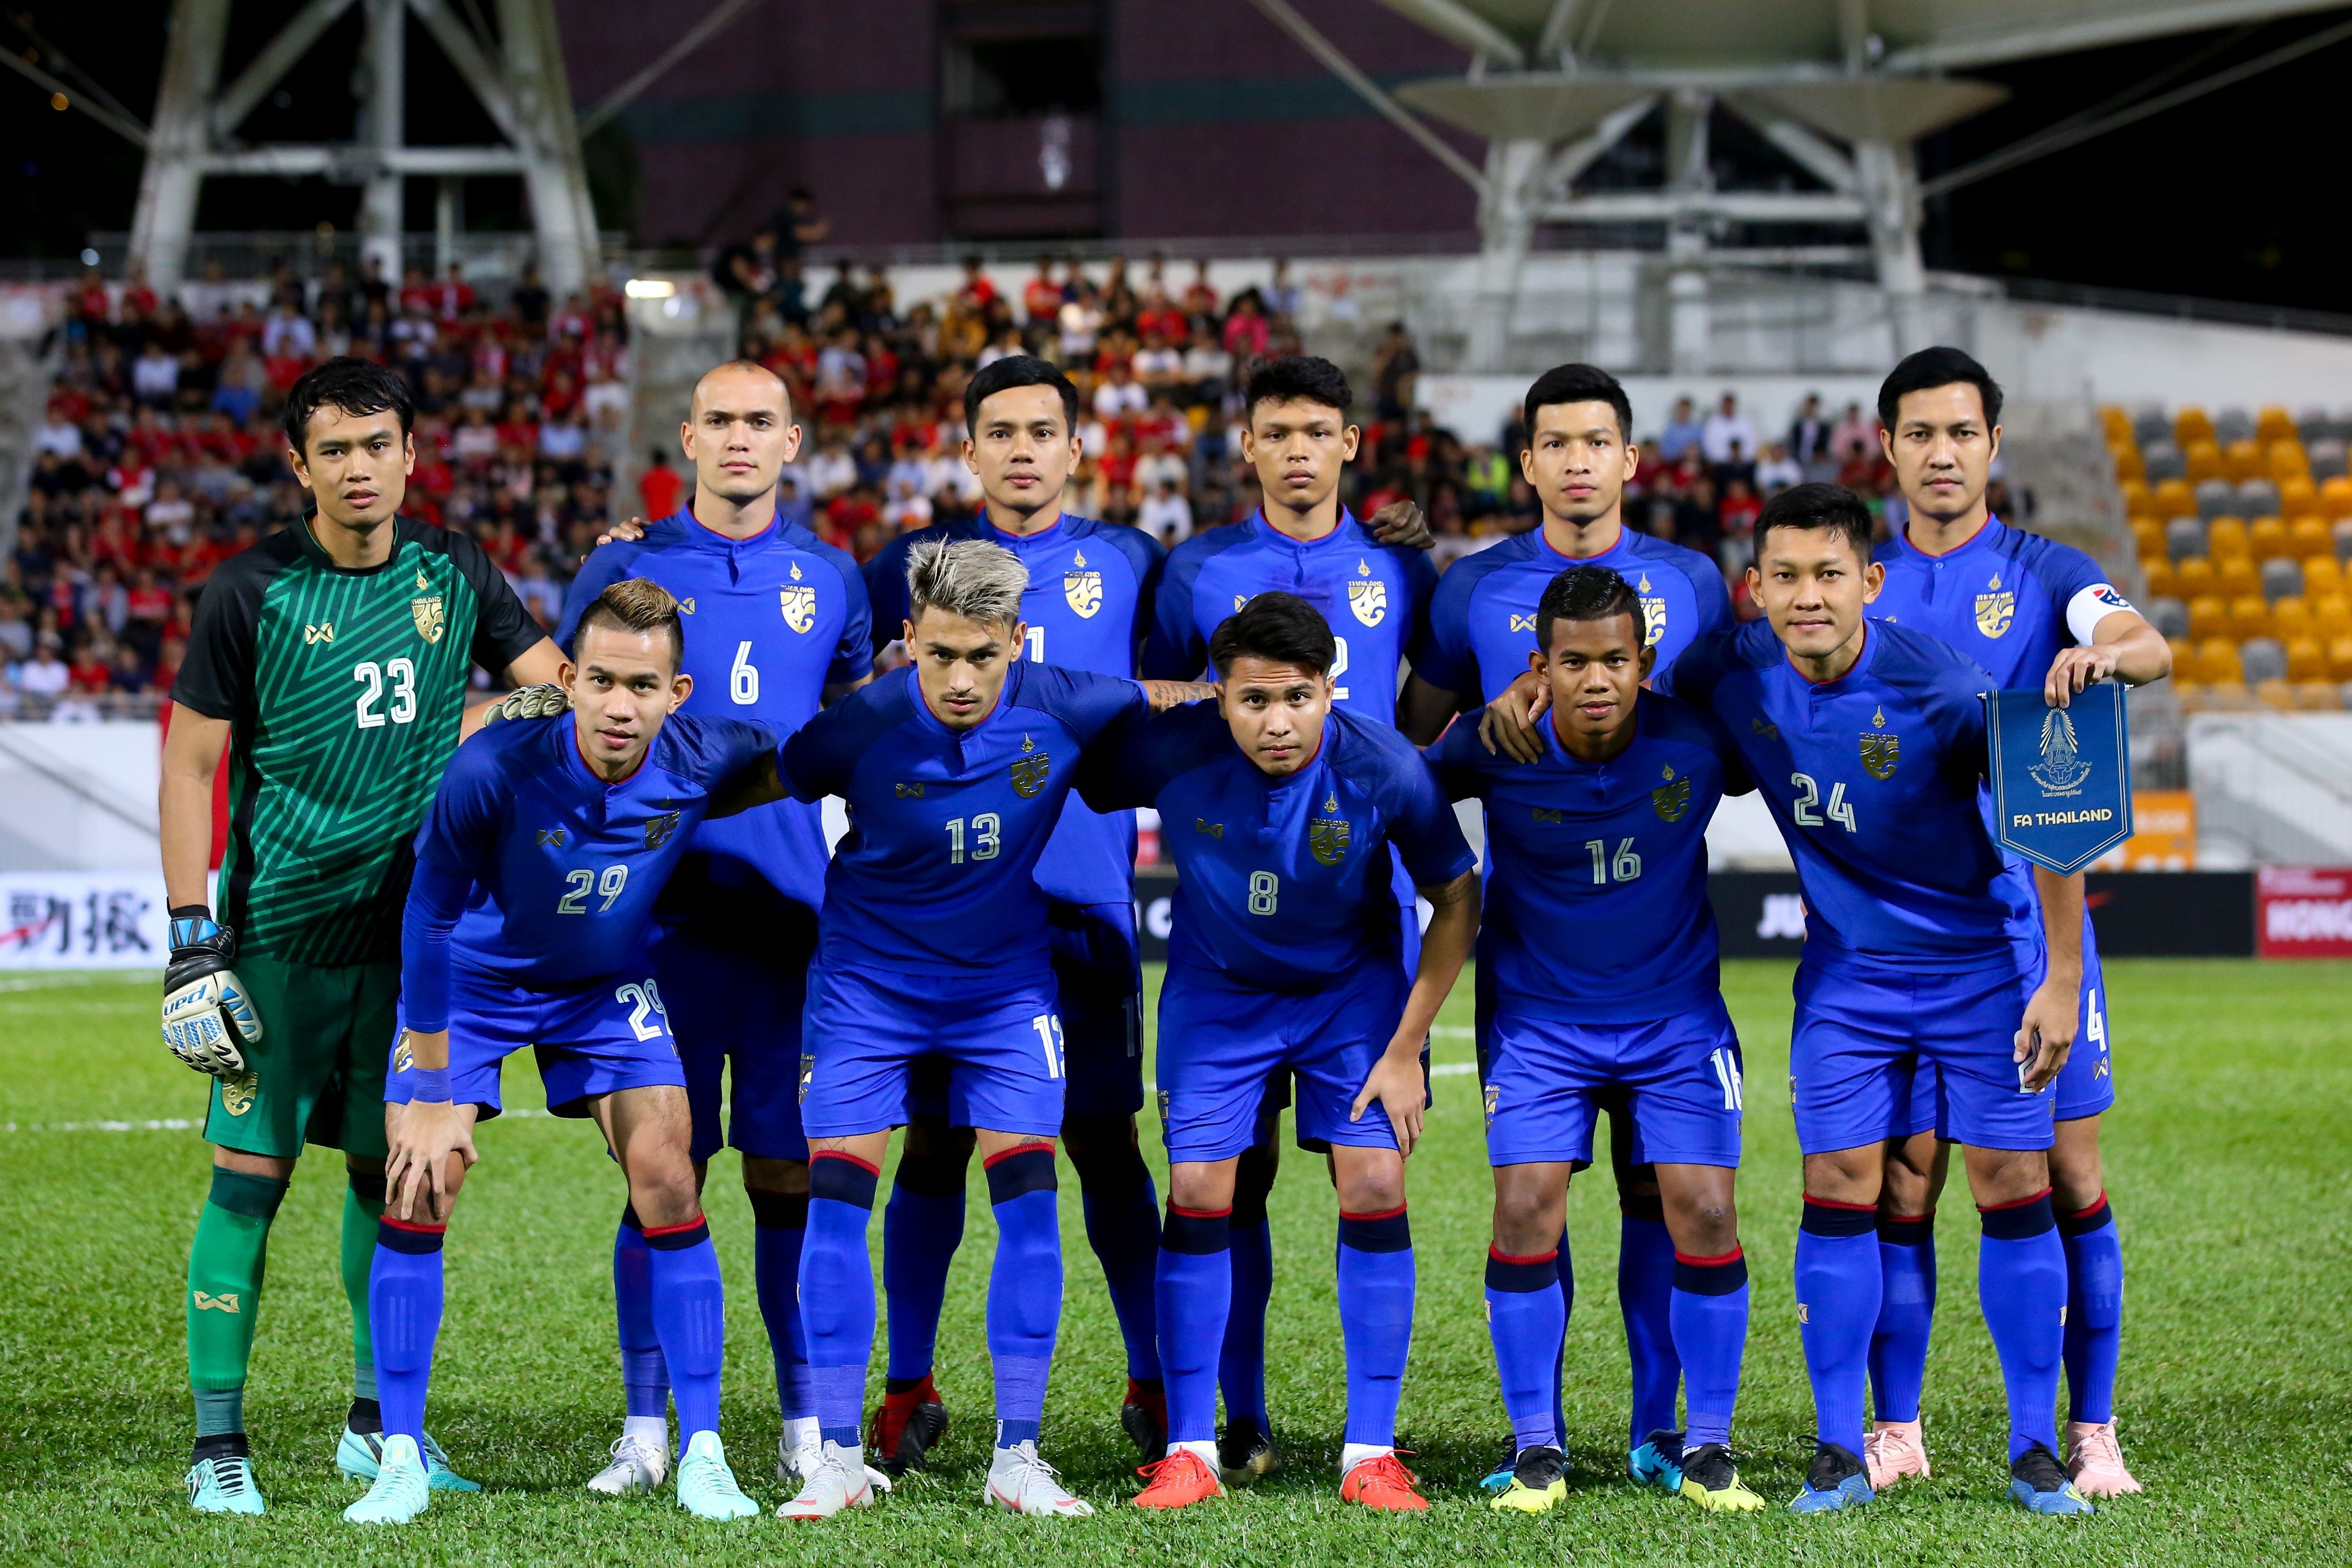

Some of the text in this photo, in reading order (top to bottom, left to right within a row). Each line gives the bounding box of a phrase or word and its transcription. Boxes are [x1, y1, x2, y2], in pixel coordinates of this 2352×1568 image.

[411, 596, 441, 605] THAILAND
[353, 658, 417, 729] 23
[730, 641, 760, 705] 6
[1791, 773, 1857, 832] 24
[2014, 808, 2113, 827] FA THAILAND
[945, 812, 1001, 864] 13
[1585, 837, 1641, 884] 16
[557, 864, 628, 914] 29
[1248, 870, 1278, 916] 8
[164, 984, 207, 1016] pan
[615, 978, 674, 1043] 29
[2086, 988, 2107, 1052] 4
[1709, 1048, 1742, 1112] 16
